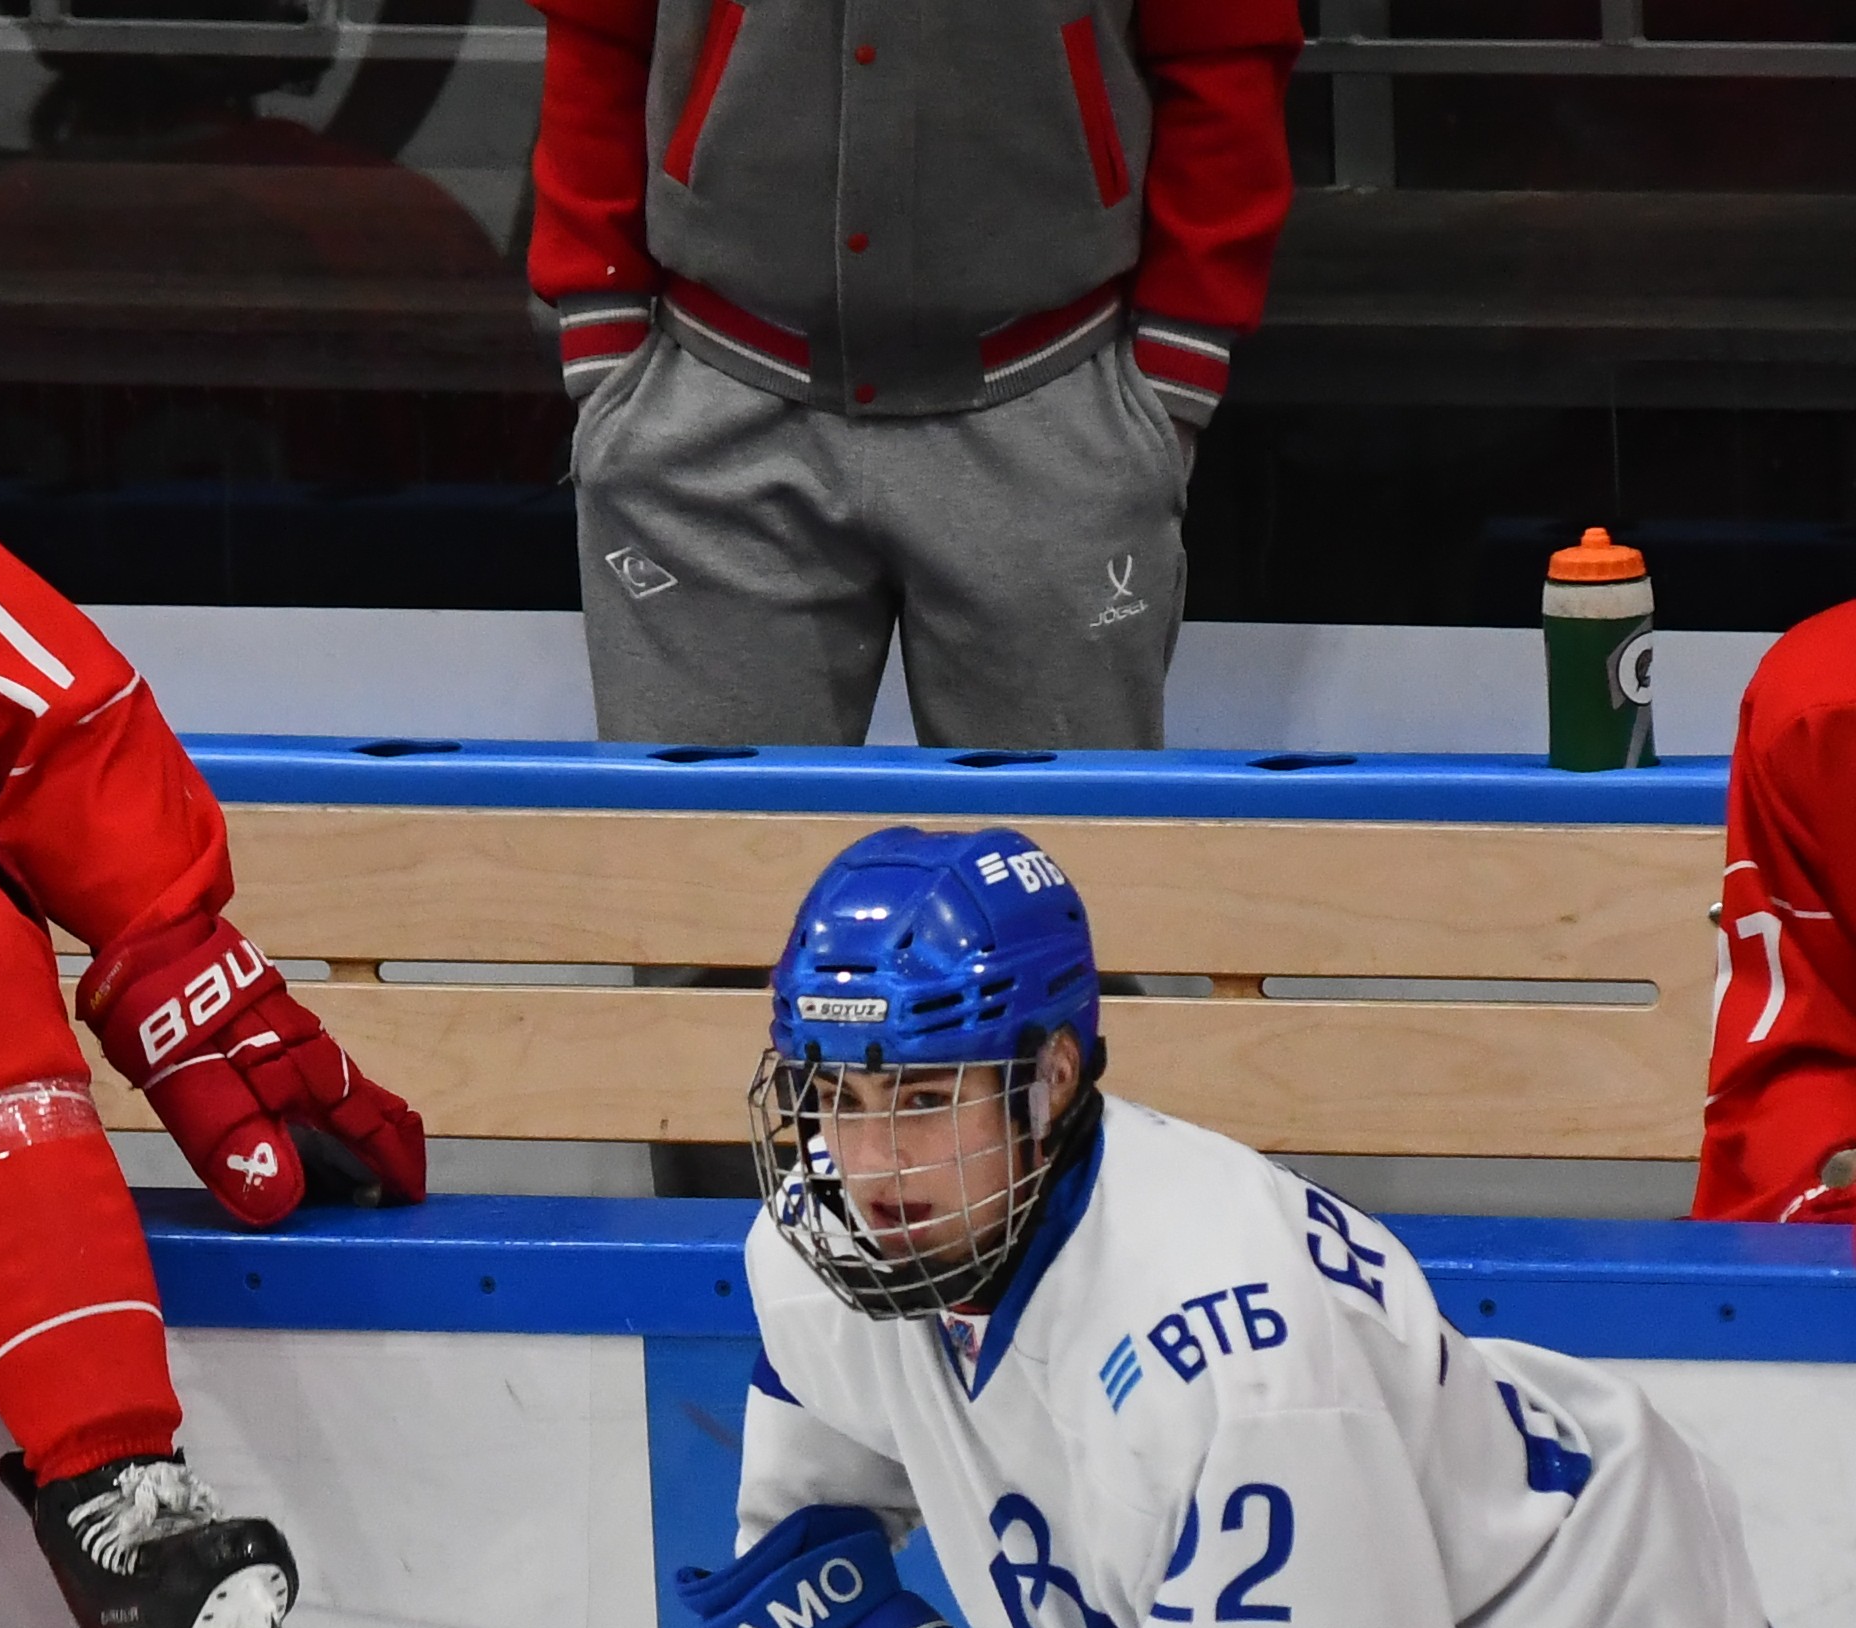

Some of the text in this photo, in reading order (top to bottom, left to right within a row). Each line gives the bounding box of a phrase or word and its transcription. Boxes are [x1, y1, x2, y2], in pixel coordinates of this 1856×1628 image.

[138, 940, 275, 1067] BAU
[820, 1003, 876, 1016] SOYUZ
[1147, 1281, 1288, 1385] ВТБ
